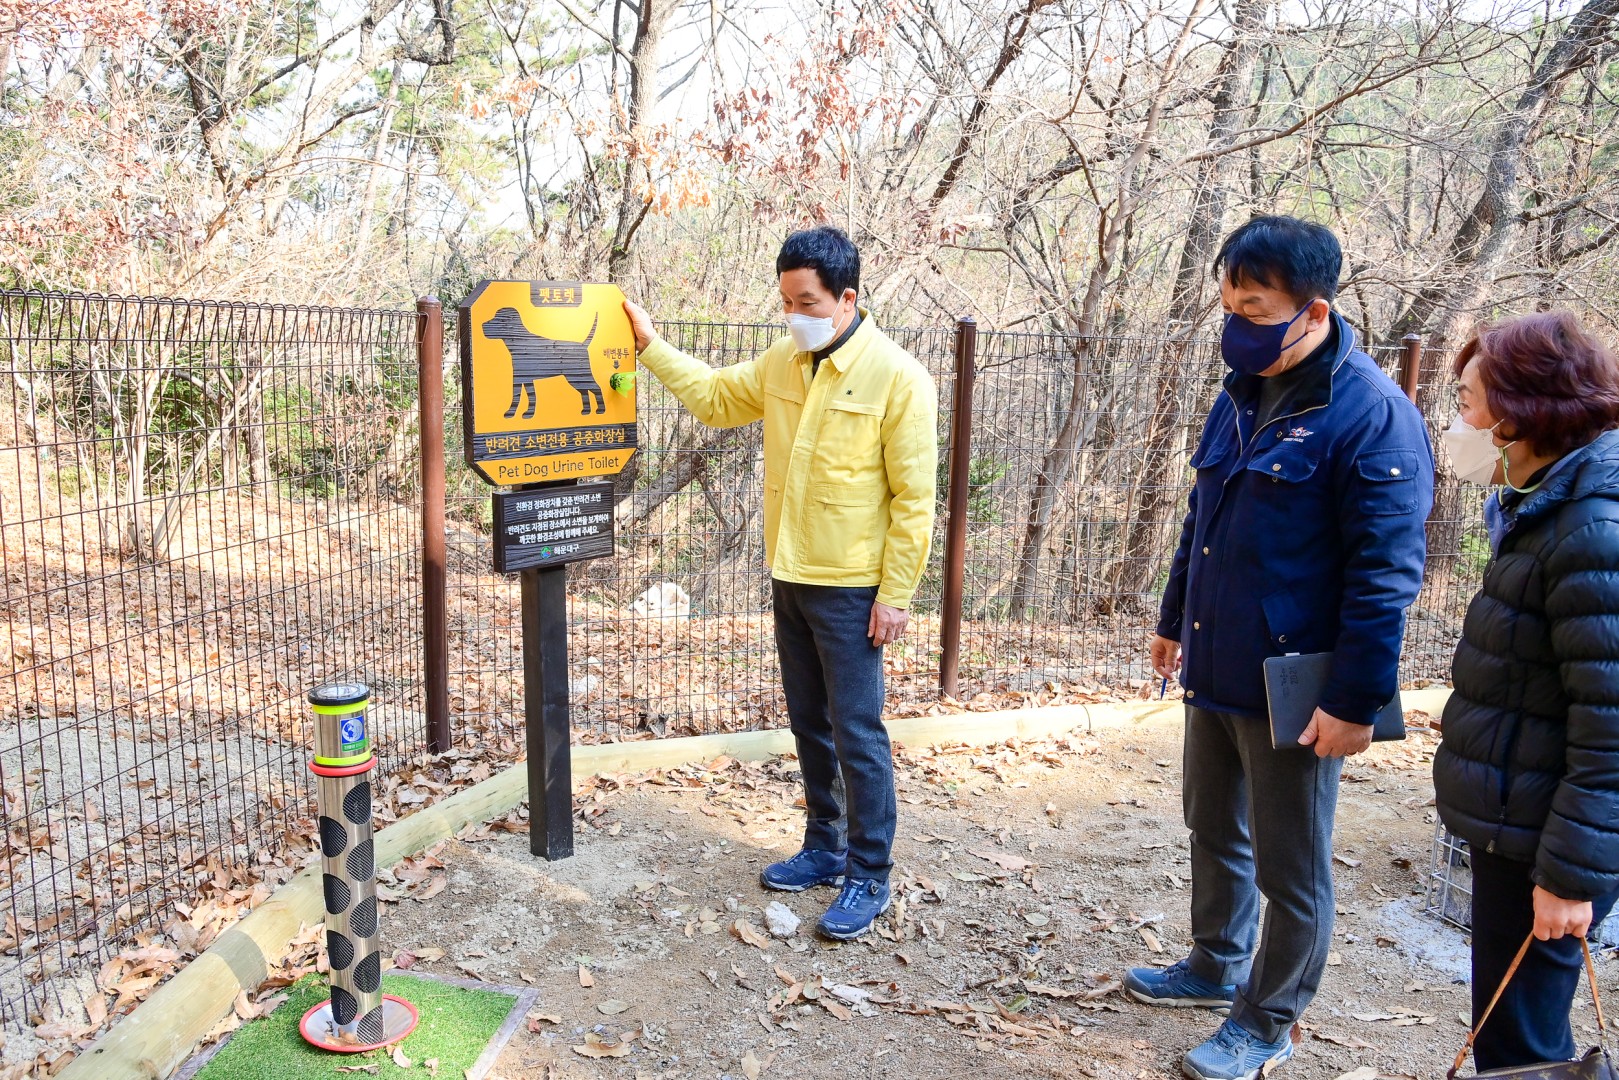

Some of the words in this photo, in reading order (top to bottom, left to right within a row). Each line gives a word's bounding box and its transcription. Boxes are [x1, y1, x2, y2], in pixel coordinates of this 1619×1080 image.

[539, 288, 575, 303] 펫토렛
[603, 348, 630, 360] 배변봉투
[485, 435, 521, 453] 반려견
[525, 432, 568, 449] 소변전용
[573, 429, 625, 446] 공중화장실
[499, 465, 519, 478] Pet
[524, 463, 548, 477] Dog
[553, 460, 584, 473] Urine
[588, 456, 619, 469] Toilet
[516, 502, 533, 511] 친환경
[534, 498, 561, 508] 정화장치를
[562, 497, 573, 506] 갖춘
[574, 494, 590, 504] 반려견
[591, 493, 601, 502] 소변
[537, 507, 582, 520] 공중화장실입니다.
[507, 524, 531, 535] 반려견도
[532, 521, 549, 531] 지정된
[549, 518, 571, 529] 장소에서
[572, 516, 588, 525] 소변을
[519, 534, 536, 544] 깨끗한
[554, 544, 580, 554] 해운대구
